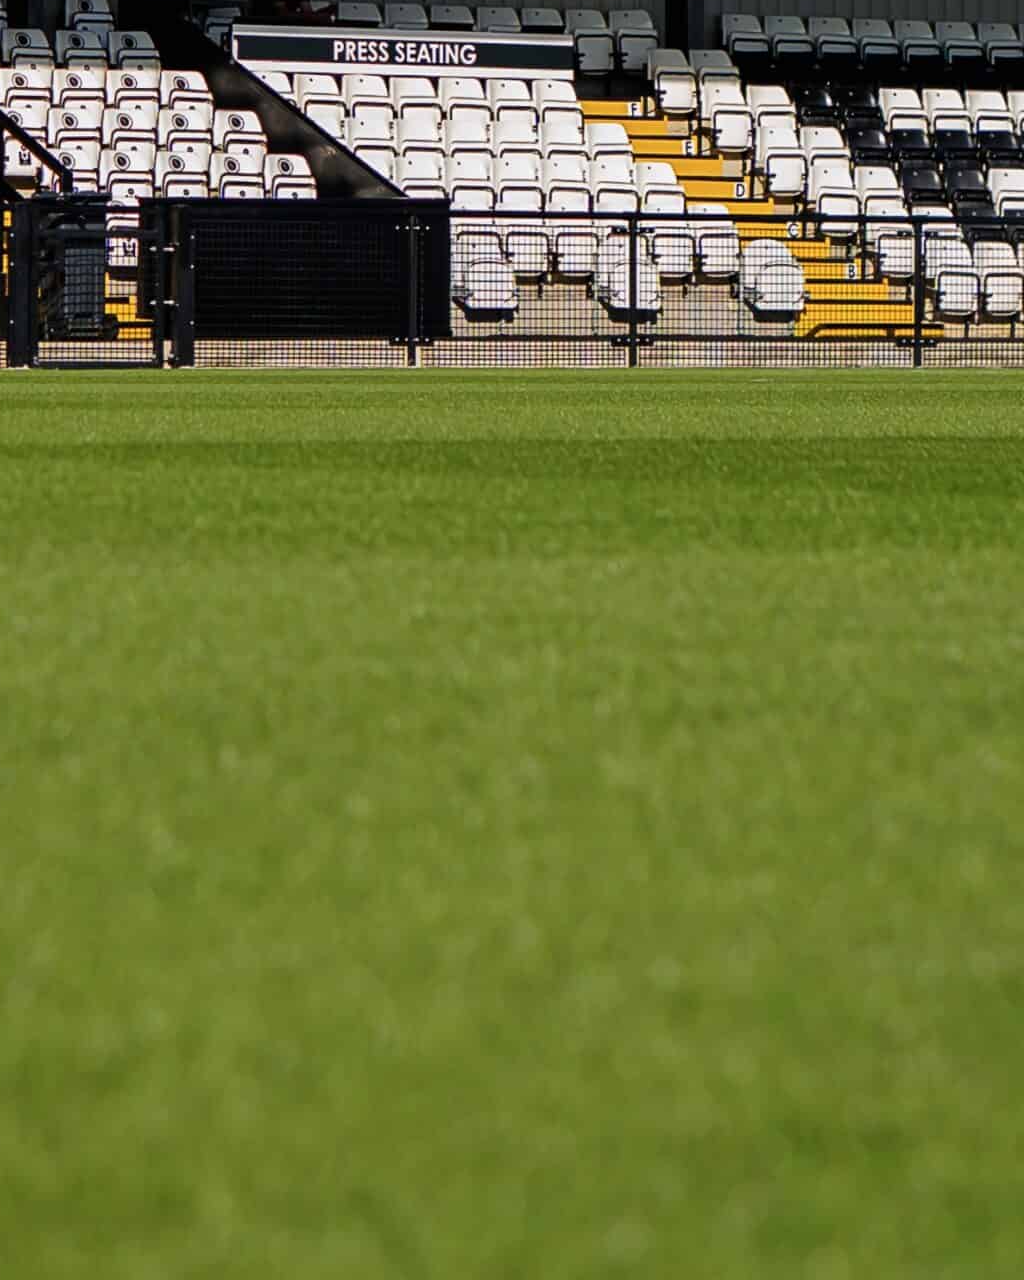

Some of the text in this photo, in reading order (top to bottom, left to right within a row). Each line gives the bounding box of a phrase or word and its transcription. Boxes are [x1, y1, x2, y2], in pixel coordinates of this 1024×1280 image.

[333, 39, 477, 65] PRESS SEATING
[631, 102, 638, 117] F
[685, 141, 693, 155] E
[736, 183, 745, 197] D
[788, 223, 799, 238] C
[848, 265, 856, 278] B
